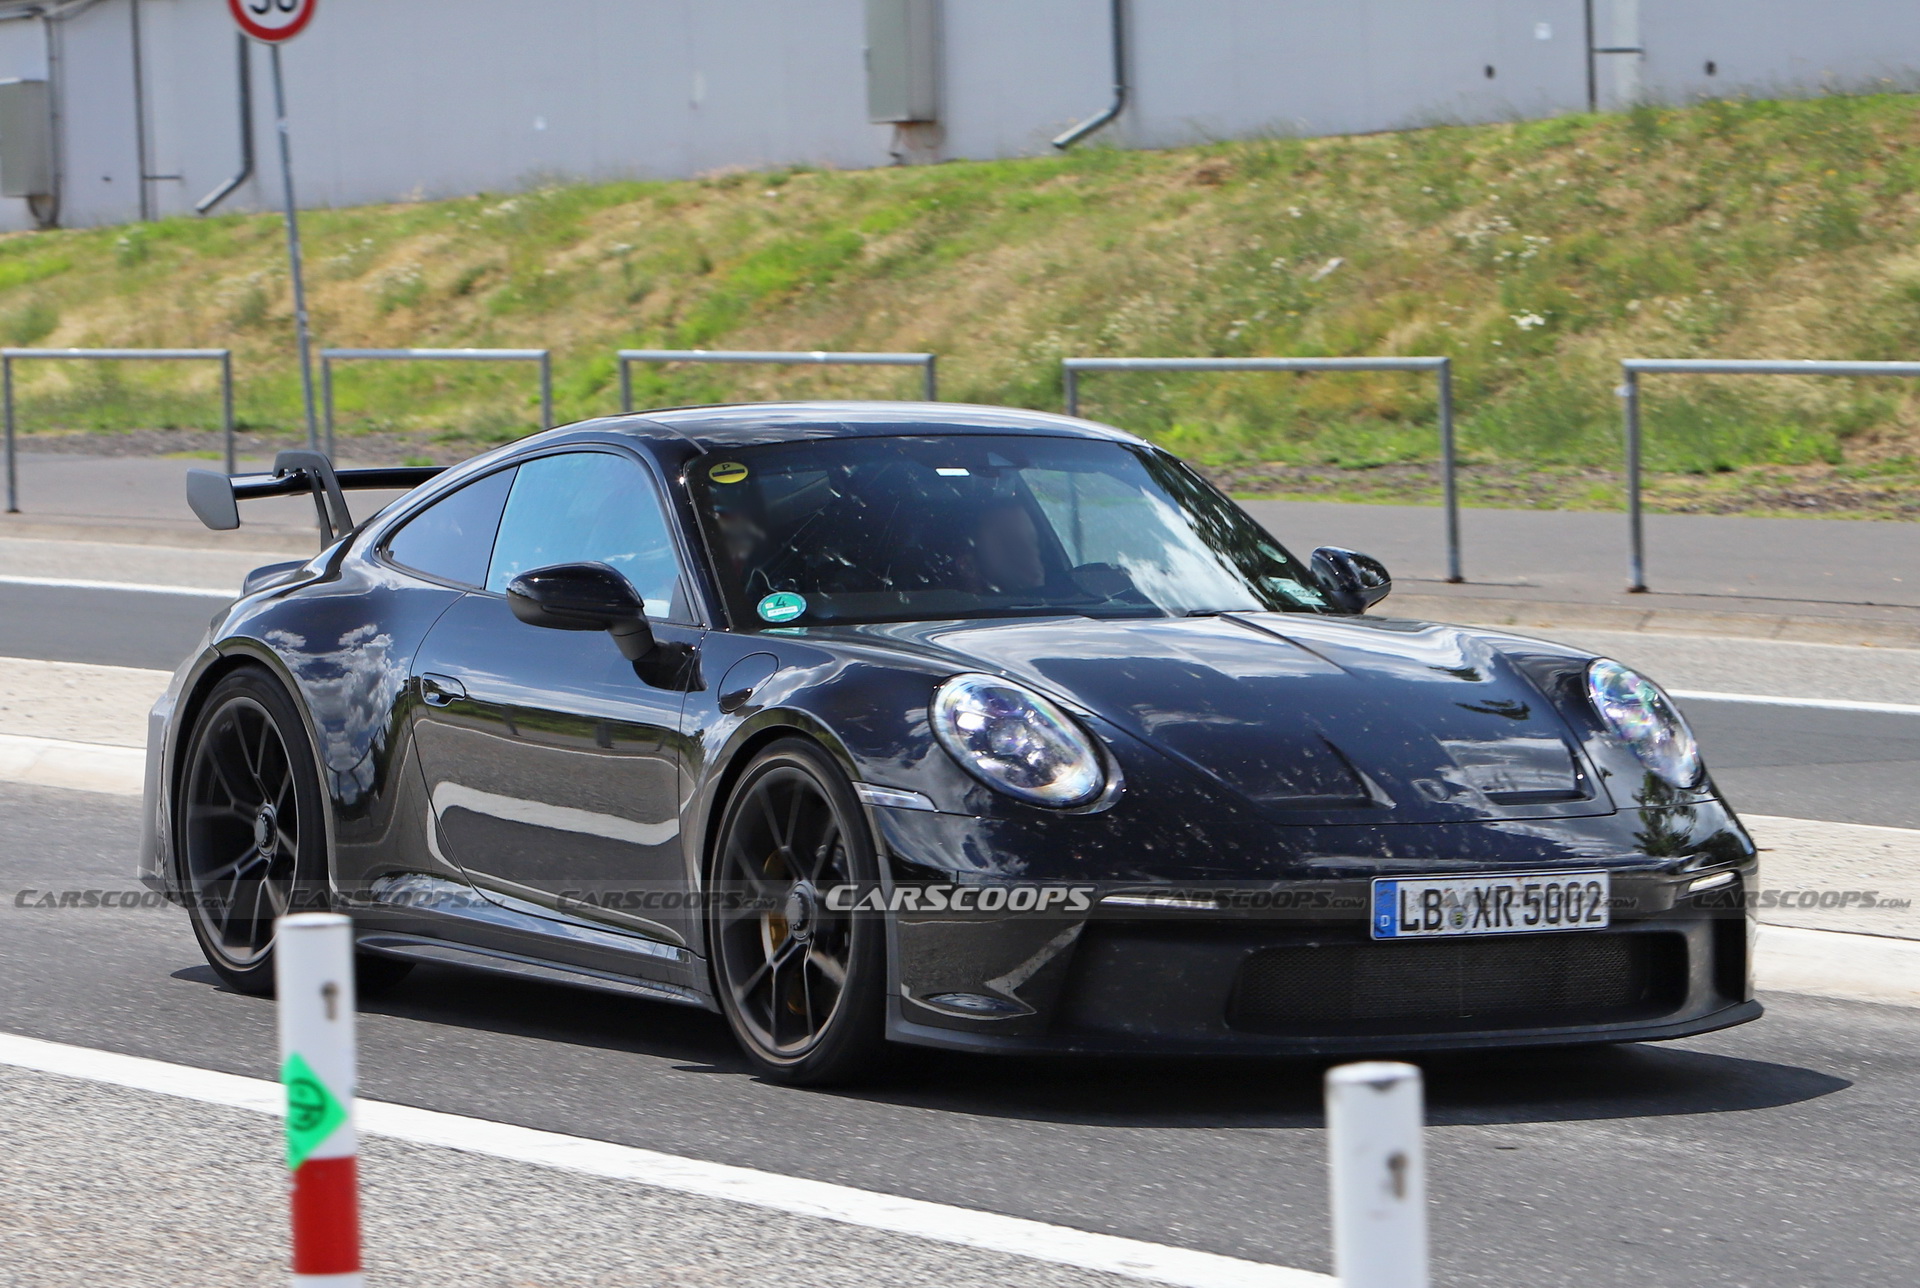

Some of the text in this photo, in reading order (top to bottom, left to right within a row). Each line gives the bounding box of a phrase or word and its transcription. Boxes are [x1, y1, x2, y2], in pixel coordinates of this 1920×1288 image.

[775, 596, 787, 607] 4
[1400, 889, 1443, 931] LB
[1472, 885, 1513, 928] XR
[1523, 880, 1603, 925] 5002
[1380, 915, 1390, 927] D
